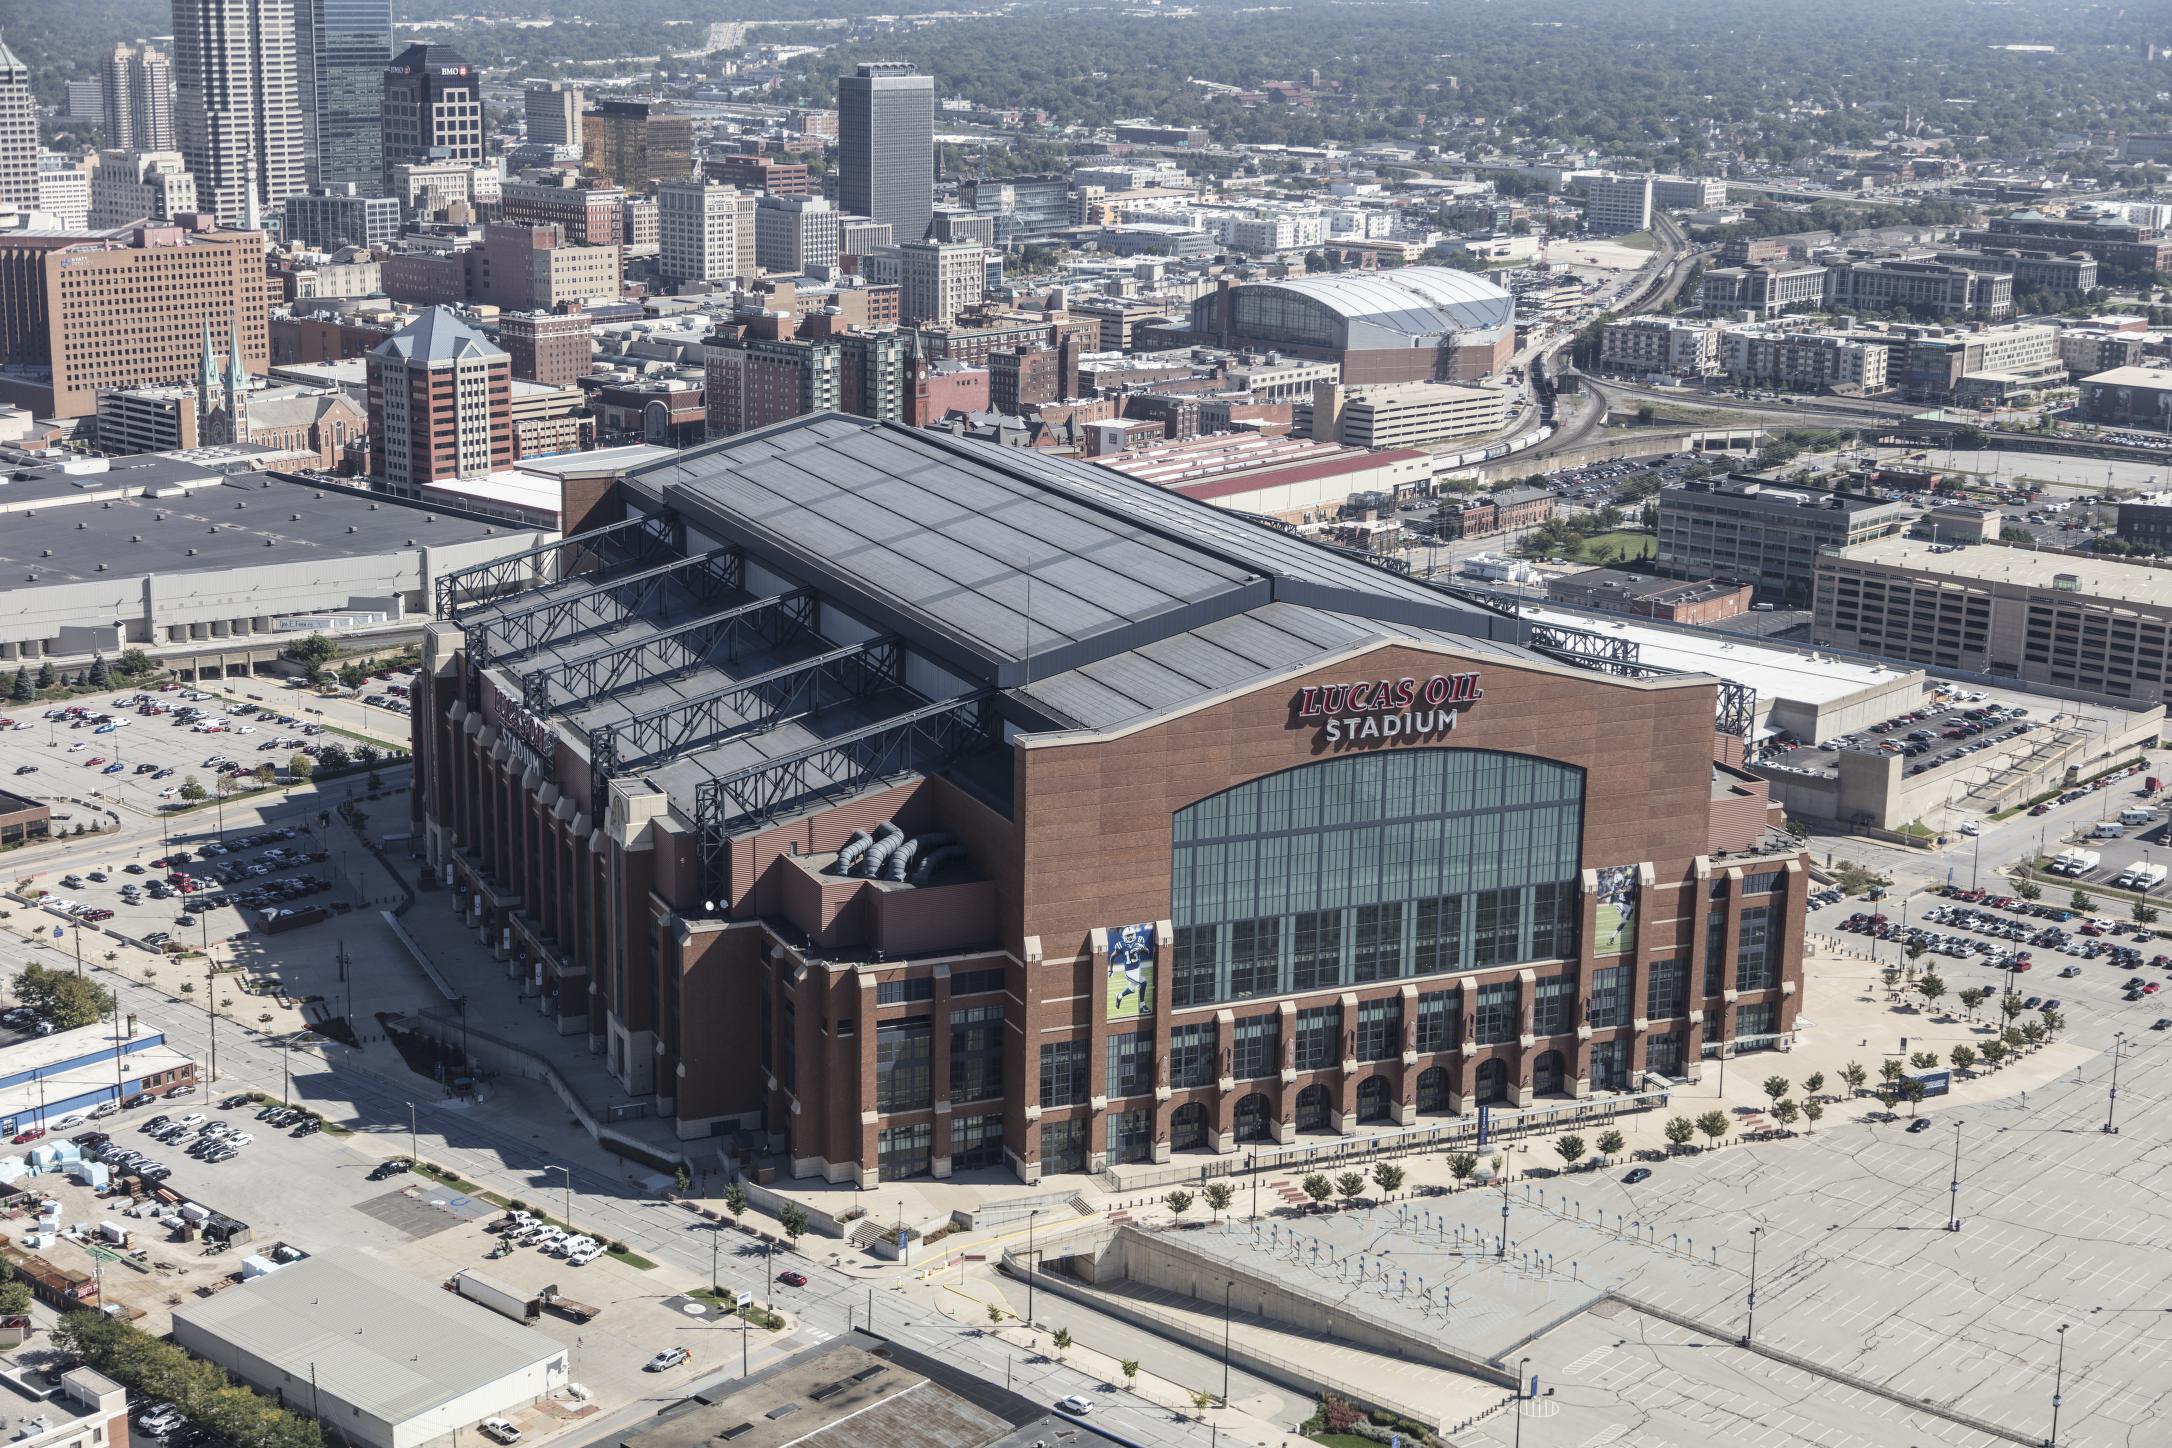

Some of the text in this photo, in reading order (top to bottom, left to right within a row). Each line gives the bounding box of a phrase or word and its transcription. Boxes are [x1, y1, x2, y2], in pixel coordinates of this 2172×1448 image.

[441, 67, 459, 76] BMO
[1299, 671, 1485, 717] LUCAS OIL
[1326, 708, 1459, 743] STADIUM
[502, 727, 540, 777] STADIUM
[1124, 950, 1139, 965] 13
